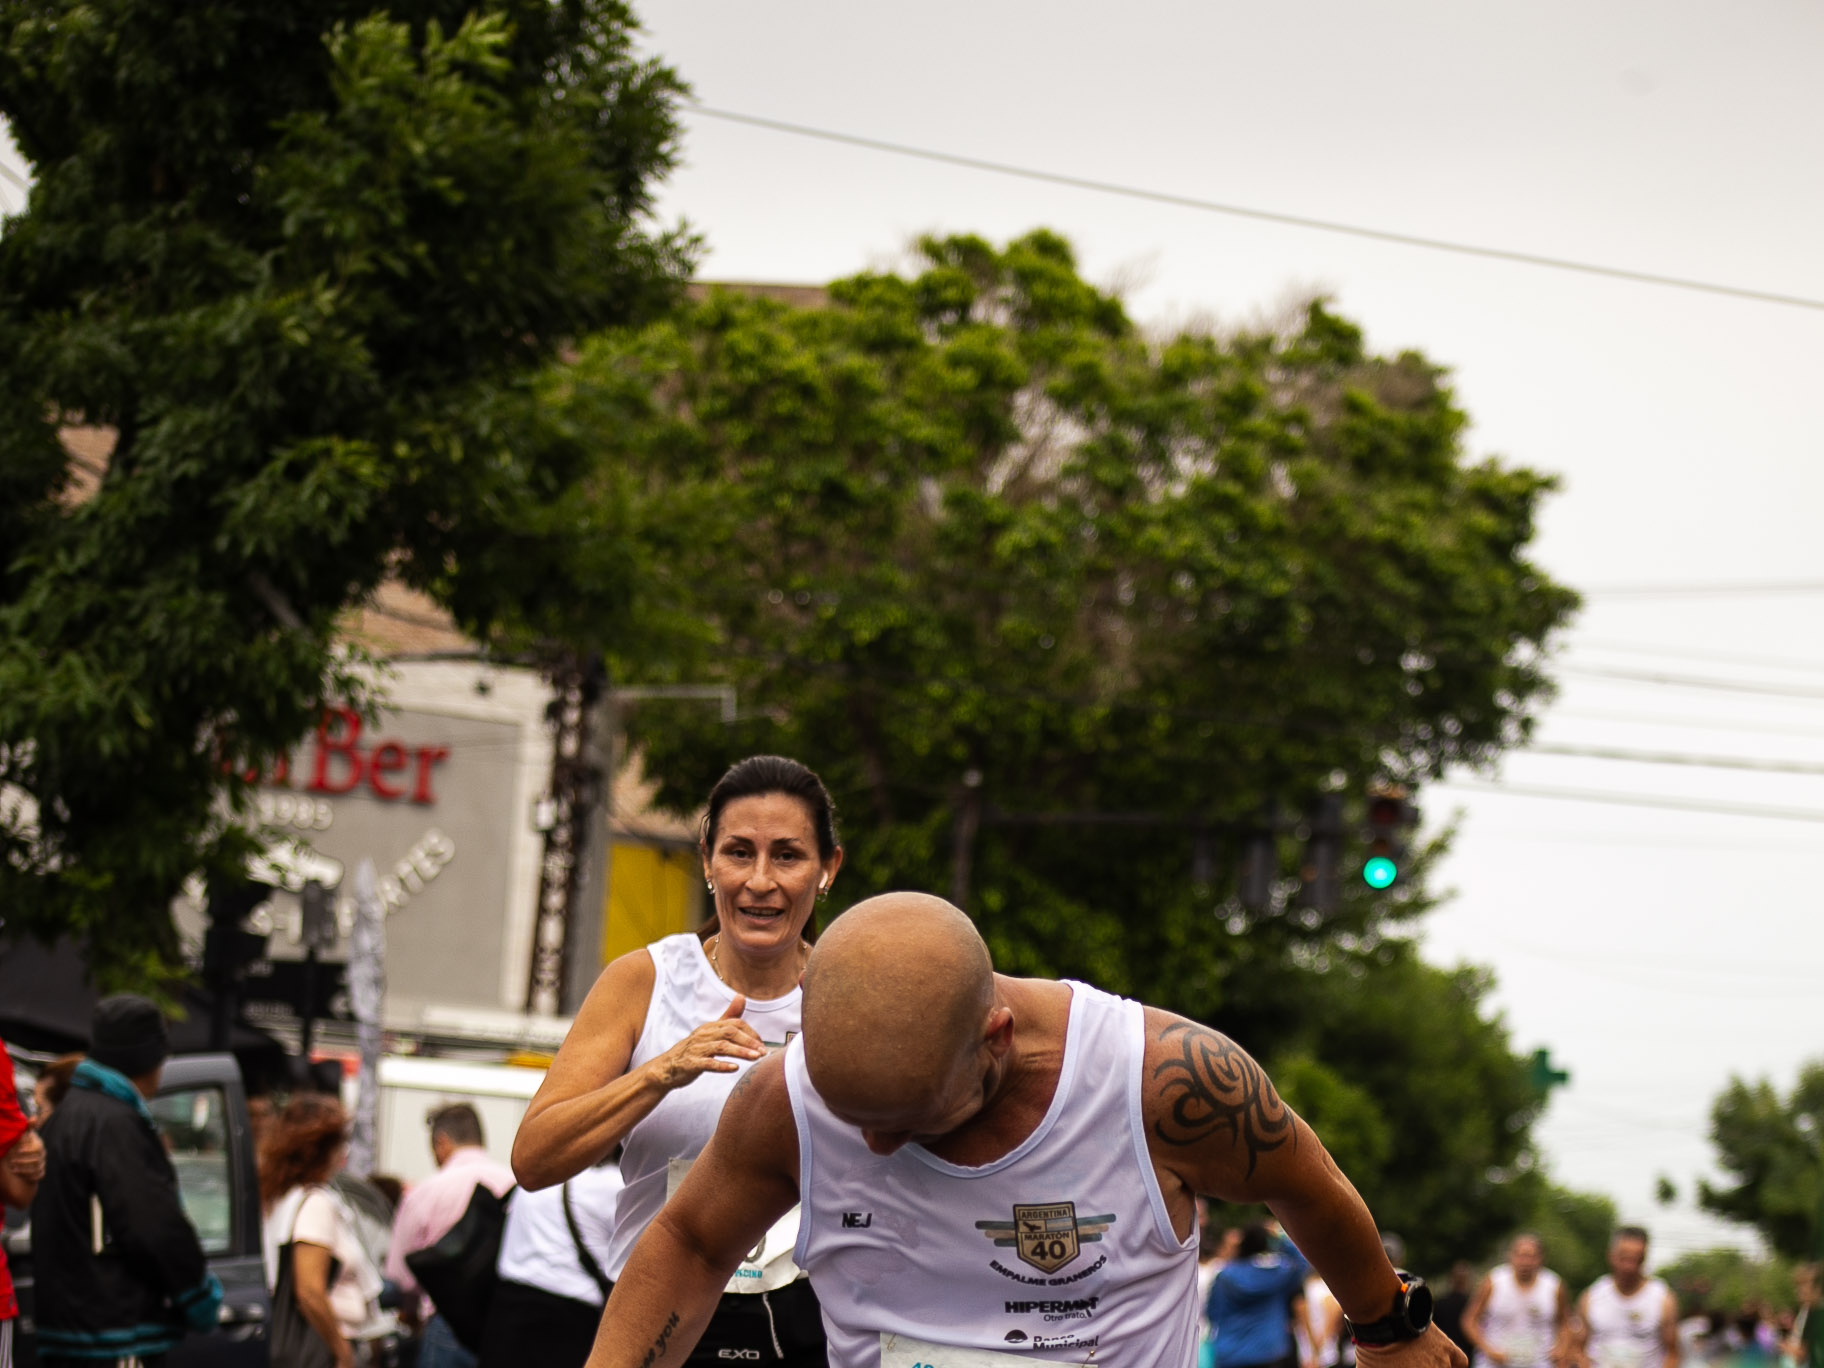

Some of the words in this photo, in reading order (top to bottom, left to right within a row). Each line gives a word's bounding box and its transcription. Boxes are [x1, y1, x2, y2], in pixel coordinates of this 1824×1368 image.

[841, 1212, 872, 1229] NEJ
[1021, 1208, 1068, 1219] ARGENTINA
[1030, 1240, 1067, 1261] 40
[989, 1259, 1047, 1287] EMPALME
[1048, 1254, 1108, 1287] GRANEROS
[1043, 1313, 1063, 1322] Otro
[656, 1311, 681, 1358] you
[717, 1348, 760, 1360] EXO
